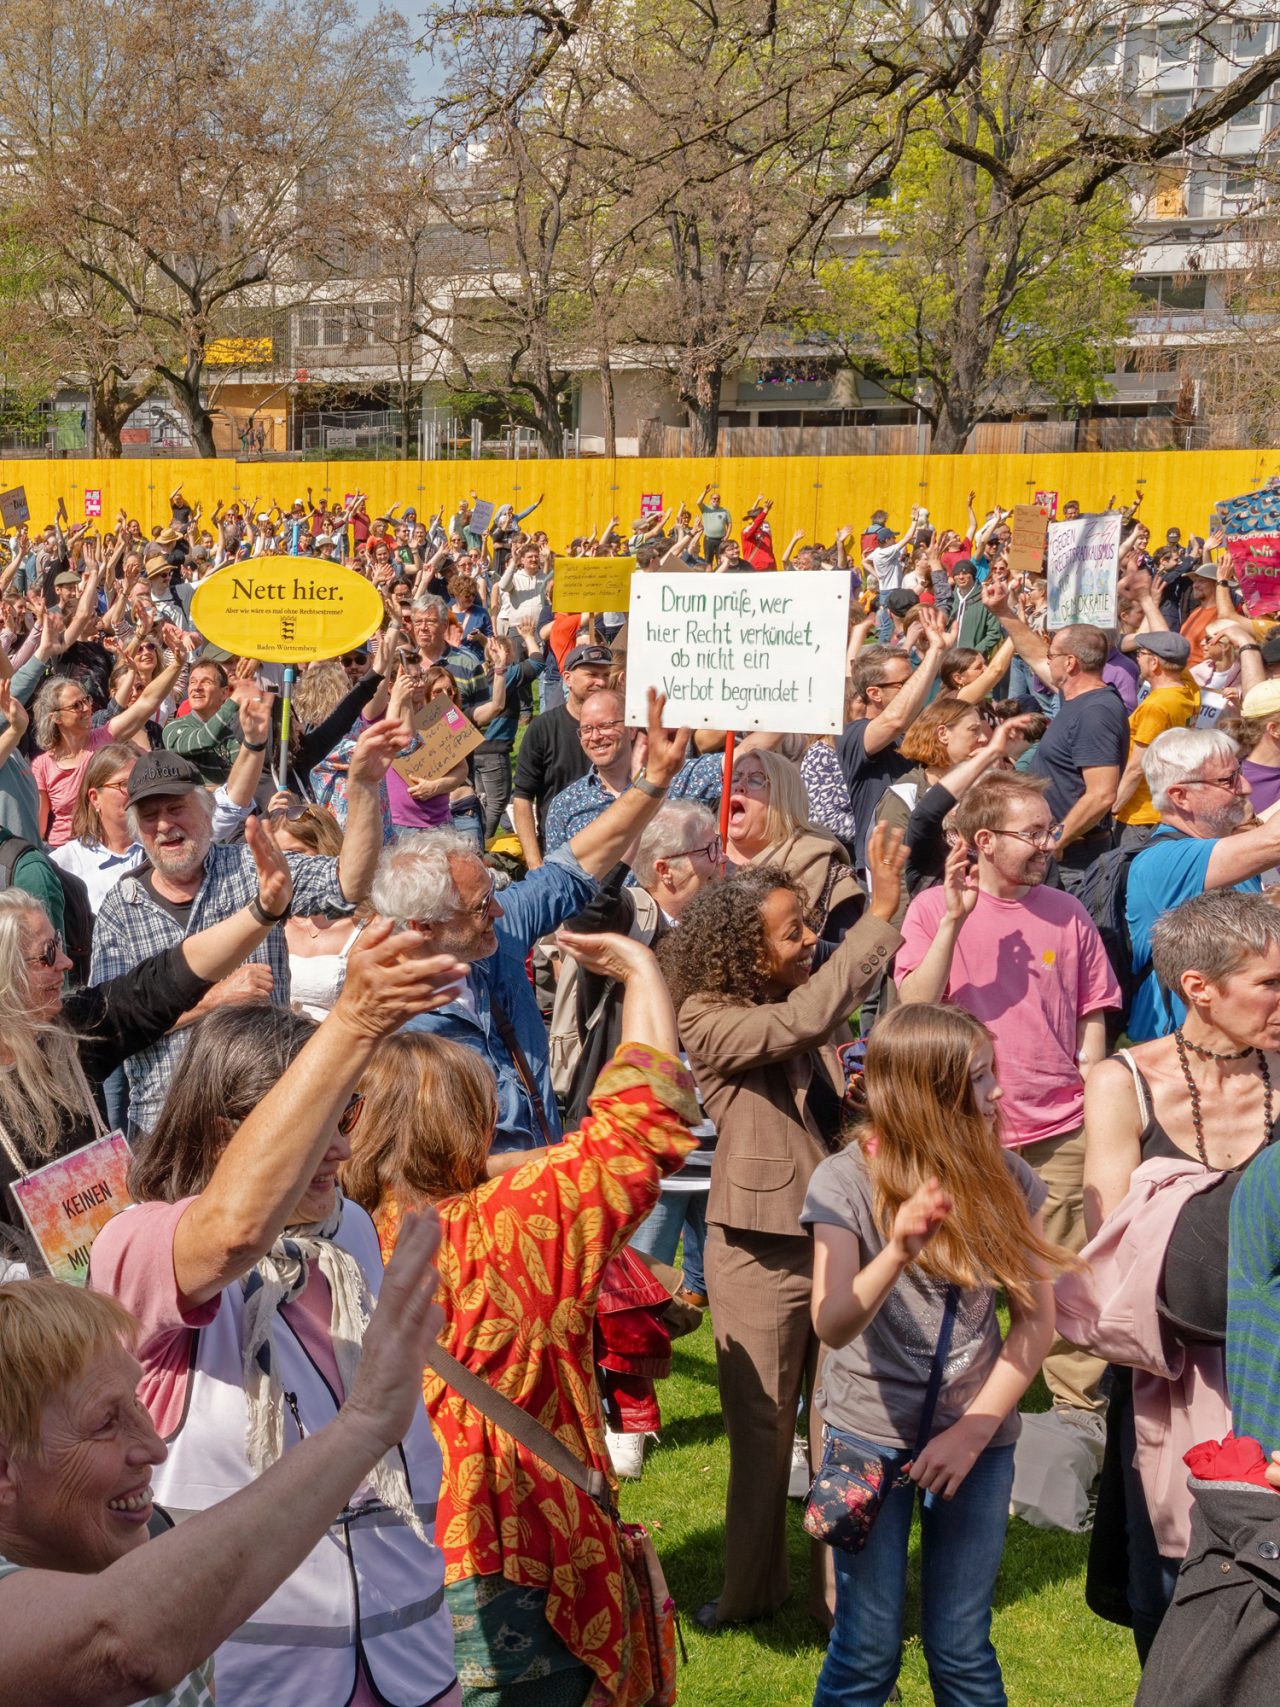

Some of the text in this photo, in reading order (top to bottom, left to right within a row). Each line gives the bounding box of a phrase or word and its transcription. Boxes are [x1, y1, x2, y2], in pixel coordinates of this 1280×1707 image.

[1052, 528, 1075, 556] GEGEN
[1249, 545, 1276, 557] Wir
[1054, 543, 1115, 573] RECHTSRADIKALISMUS
[232, 578, 344, 601] Nett hier.
[661, 585, 793, 619] Drum prüfe, wer
[1061, 593, 1109, 622] DEMOKRATIE
[647, 620, 820, 653] hier Recht verkündet,
[671, 647, 769, 670] ob nicht ein
[663, 676, 714, 701] Verbot
[722, 678, 799, 710] begründet
[62, 1180, 113, 1219] KEINEN
